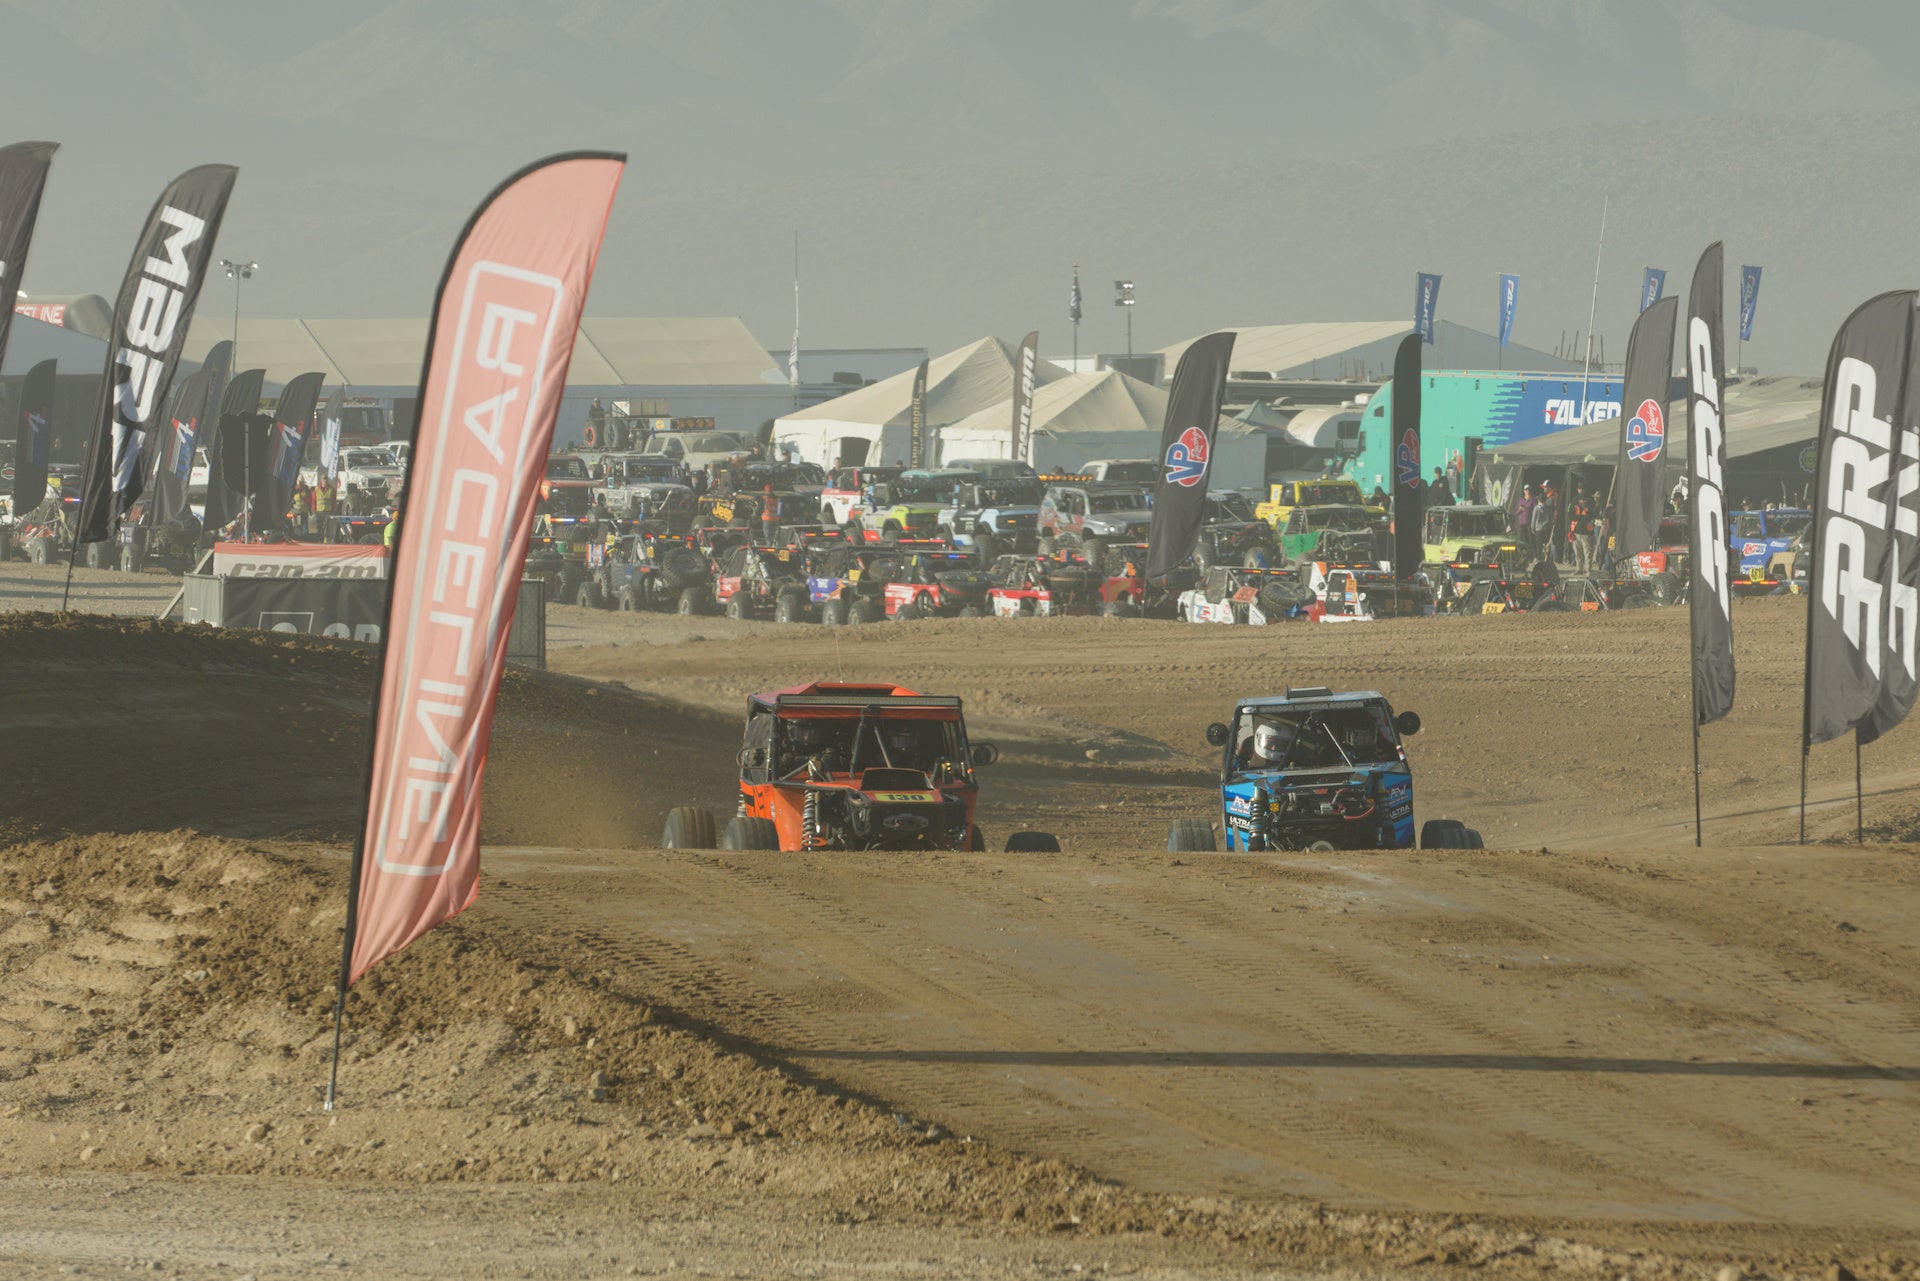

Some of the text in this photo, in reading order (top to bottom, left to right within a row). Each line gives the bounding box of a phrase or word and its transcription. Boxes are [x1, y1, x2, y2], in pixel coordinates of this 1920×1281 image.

[1626, 416, 1664, 460] VP
[1165, 442, 1208, 483] VP
[1397, 443, 1420, 484] VP
[712, 501, 733, 522] Jeep
[1823, 356, 1893, 681] PRP
